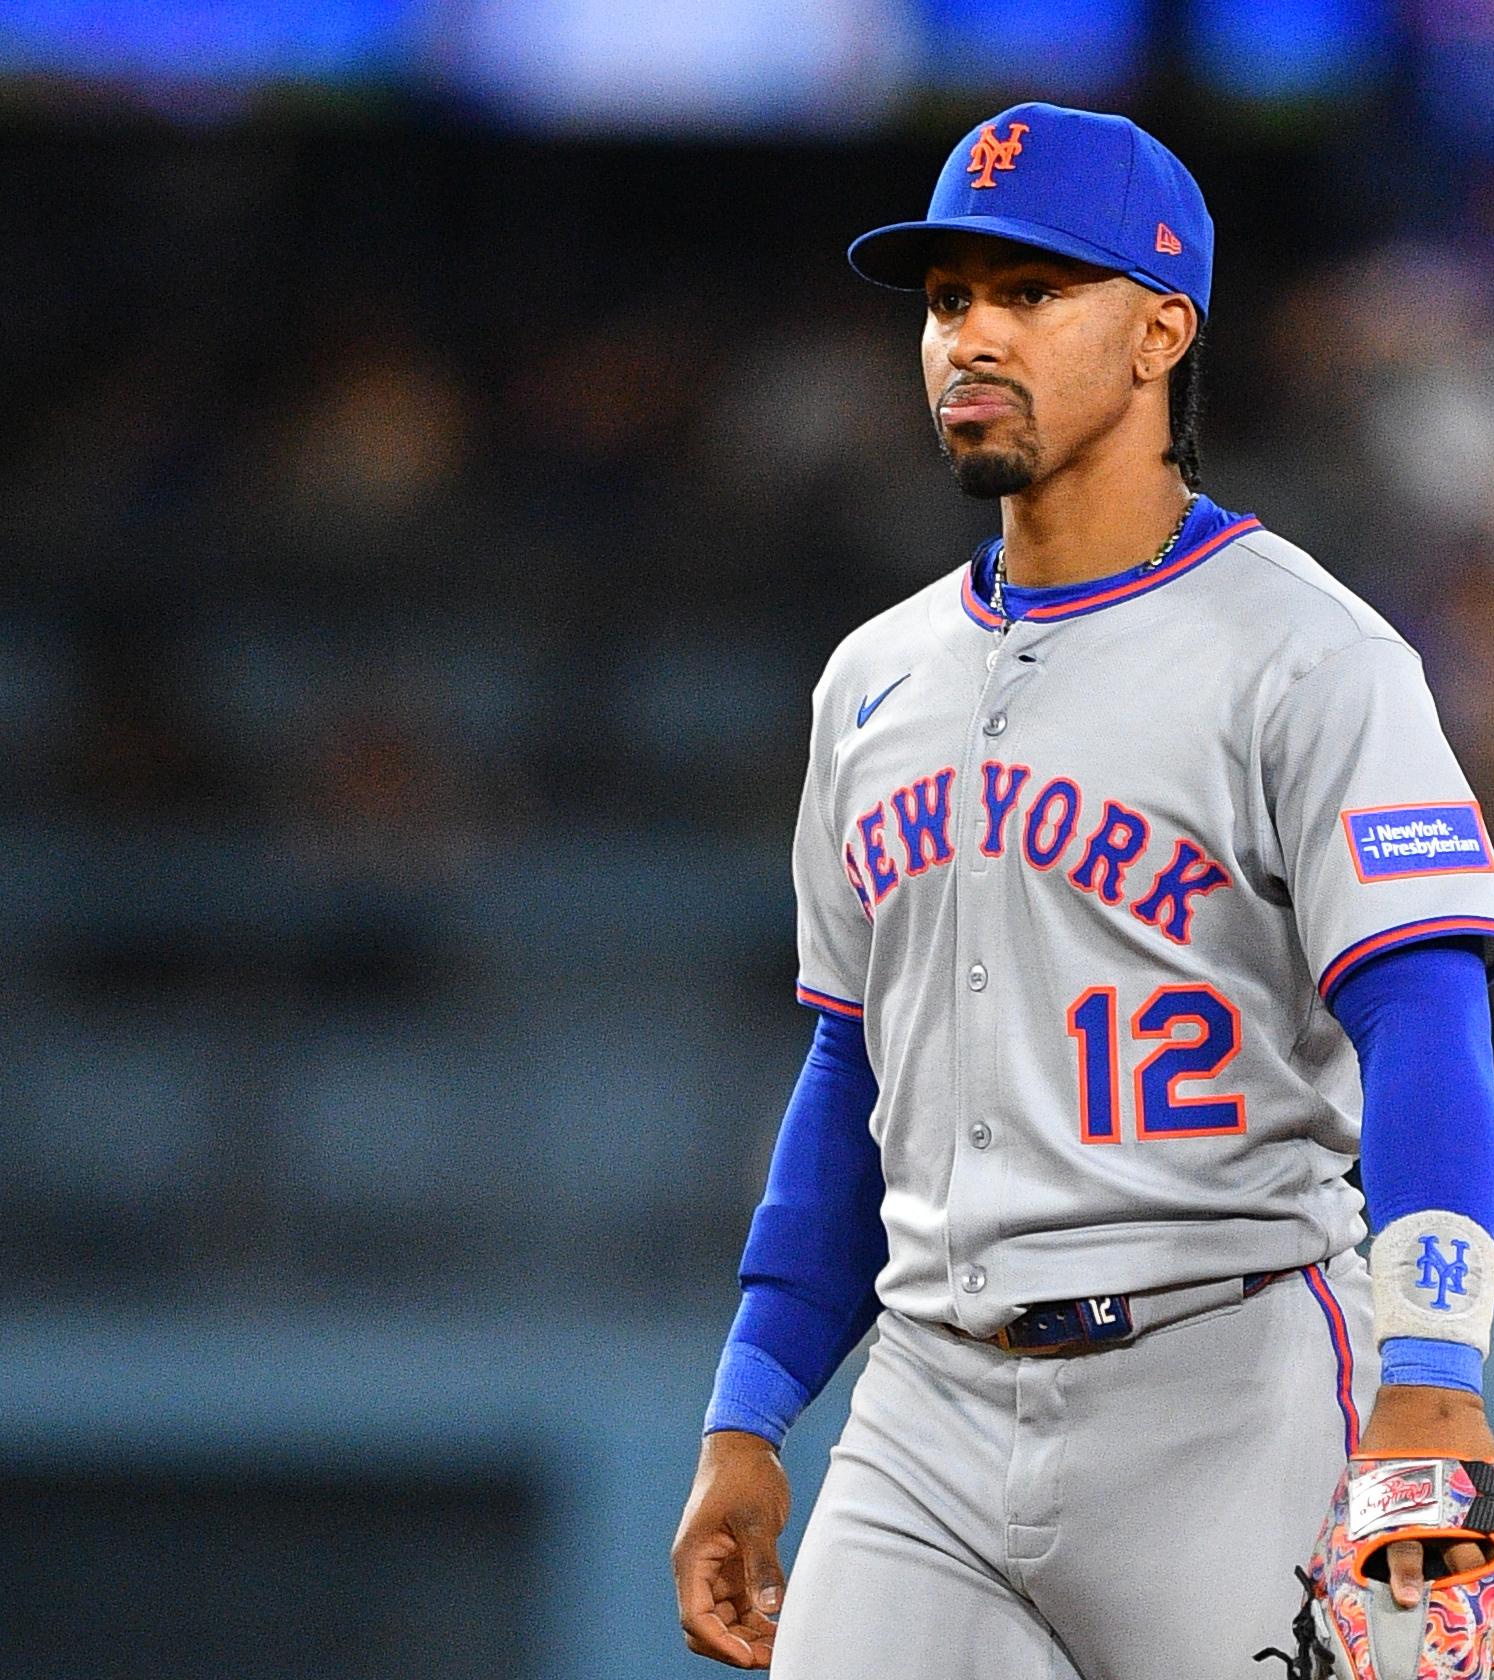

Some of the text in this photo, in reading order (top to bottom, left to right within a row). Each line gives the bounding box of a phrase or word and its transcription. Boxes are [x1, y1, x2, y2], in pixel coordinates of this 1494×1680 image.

[980, 759, 1233, 946] YORK
[1381, 835, 1480, 858] Presbyterian
[1066, 980, 1248, 1145] 12
[1088, 1297, 1116, 1325] 12
